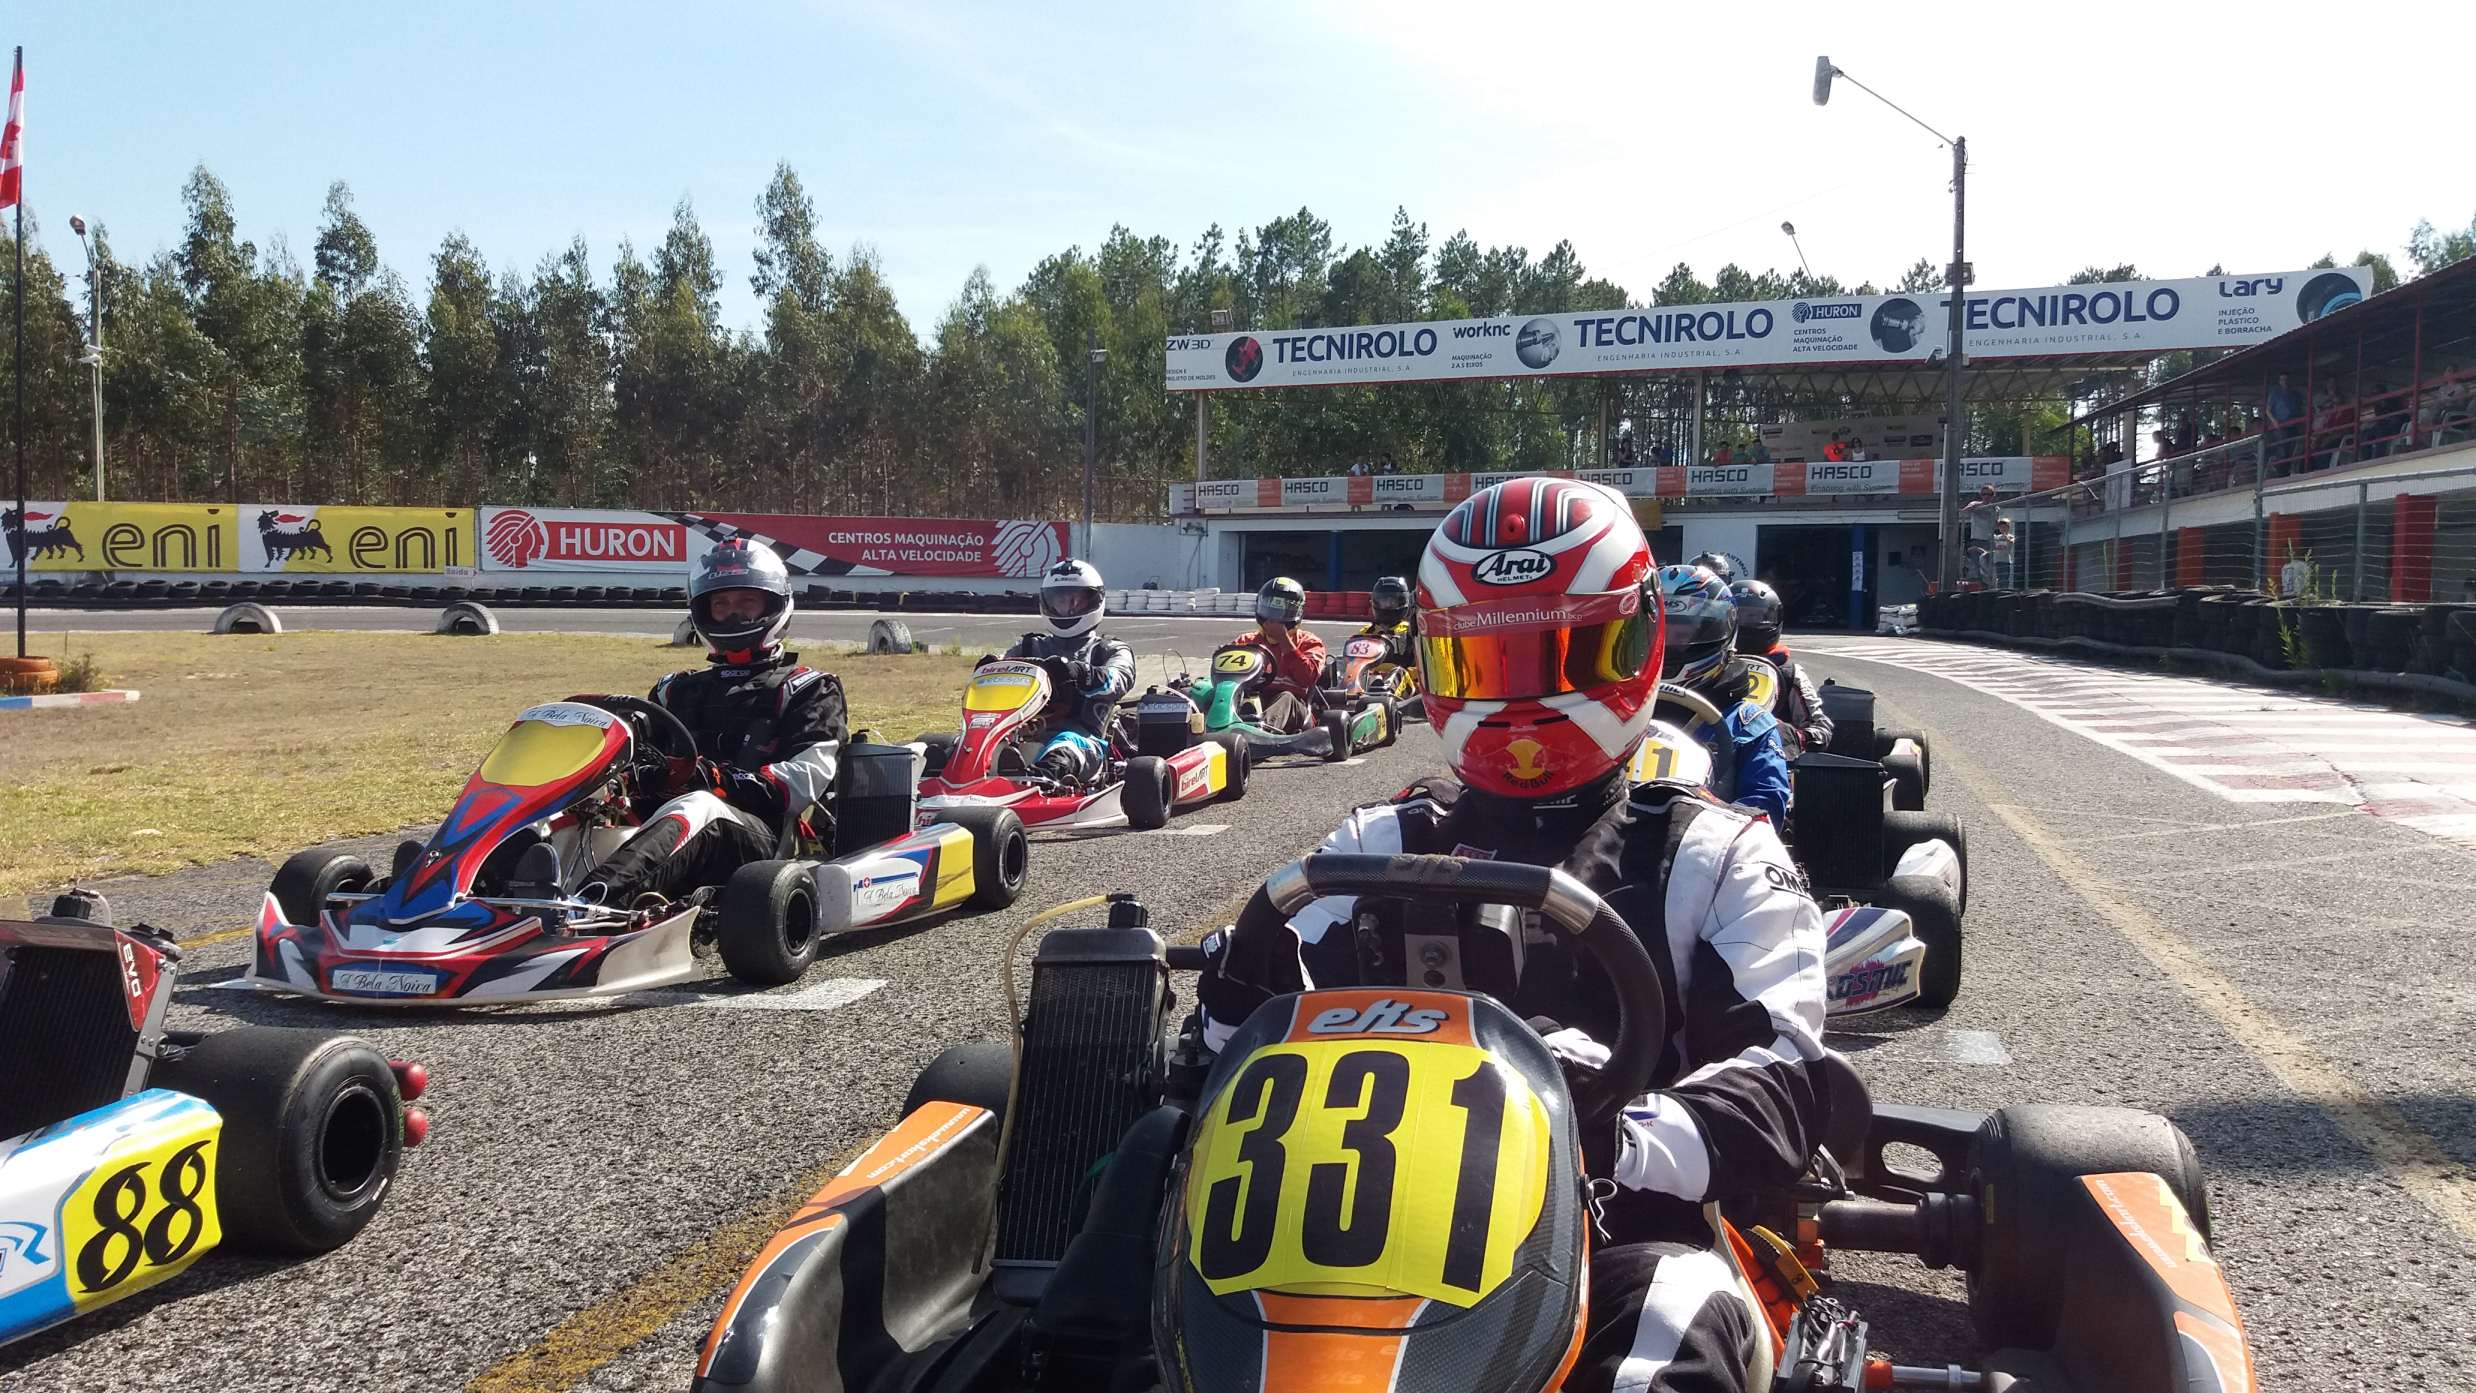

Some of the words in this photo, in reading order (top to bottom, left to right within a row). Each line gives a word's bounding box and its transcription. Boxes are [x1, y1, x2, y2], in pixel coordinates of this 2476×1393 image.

[1815, 305, 1858, 318] HURON
[2218, 306, 2255, 316] INJEÇÃO
[1452, 321, 1511, 339] worknc
[1573, 308, 1774, 348] TECNIROLO
[1793, 328, 1827, 336] CENTROS
[2224, 326, 2272, 335] BORRACHA
[1272, 328, 1438, 364] TECNIROLO
[1793, 336, 1843, 344] MAQUINAÇÃO
[1968, 336, 2040, 347] ENGENHARIA
[1812, 344, 1858, 352] VELOCIDADE
[1451, 353, 1492, 362] MAQUINAÇÃO
[1597, 353, 1656, 362] ENGENHARIA
[1292, 369, 1341, 377] ENGENHARIA
[1691, 468, 1748, 483] HASCO
[1811, 465, 1872, 480] HASCO
[1198, 484, 1239, 496] HASCO
[1284, 481, 1328, 494] HASCO
[1376, 478, 1424, 491] HASCO
[101, 507, 221, 568] eni
[348, 511, 458, 569] eni
[559, 527, 675, 557] HURON
[828, 532, 891, 544] CENTROS
[894, 532, 984, 549] MAQUINAÇÃO
[861, 549, 897, 561] ALTA
[900, 550, 982, 562] VELOCIDADE
[1476, 553, 1547, 580] Arai
[1497, 574, 1530, 583] HELMET
[1476, 607, 1567, 627] Millennium
[1217, 654, 1248, 668] 74
[1199, 1049, 1508, 1294] 331
[76, 1138, 212, 1293] 88
